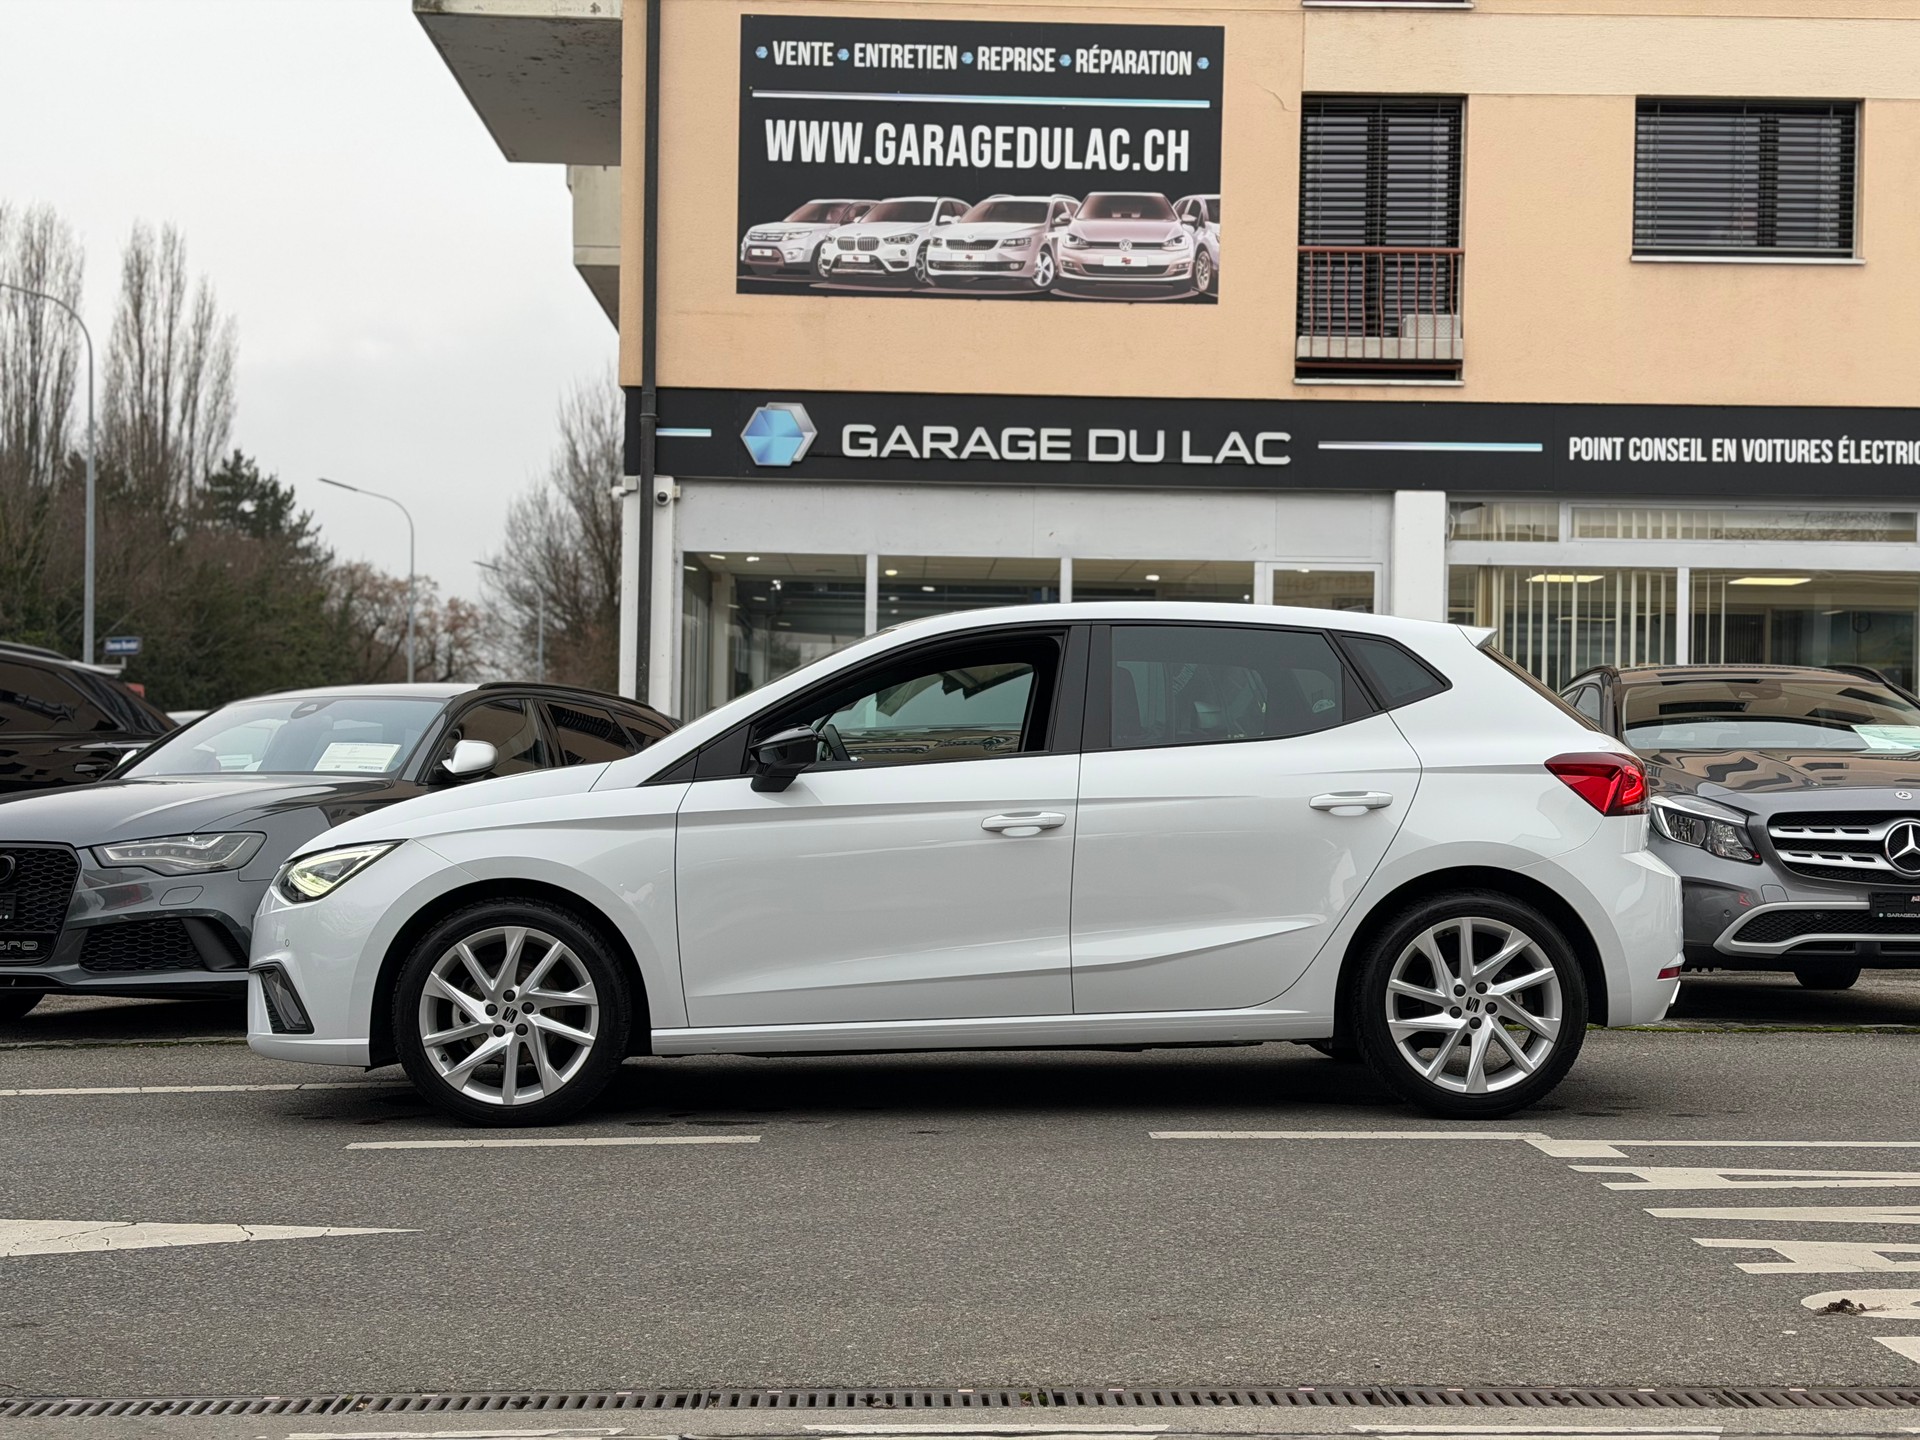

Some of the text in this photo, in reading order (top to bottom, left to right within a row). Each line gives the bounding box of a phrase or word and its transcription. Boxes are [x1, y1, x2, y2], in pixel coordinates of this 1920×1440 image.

[773, 41, 1192, 75] VENTE ENTRETIEN REPRISE RÉPARATION
[766, 119, 1188, 171] WWW.GARAGEDULAC.CH
[843, 425, 1291, 464] GARAGE DU LAC
[1570, 437, 1624, 460] POINT
[1629, 438, 1707, 461] CONSEIL
[1712, 439, 1736, 462] EN
[1742, 439, 1833, 463] VOITURES
